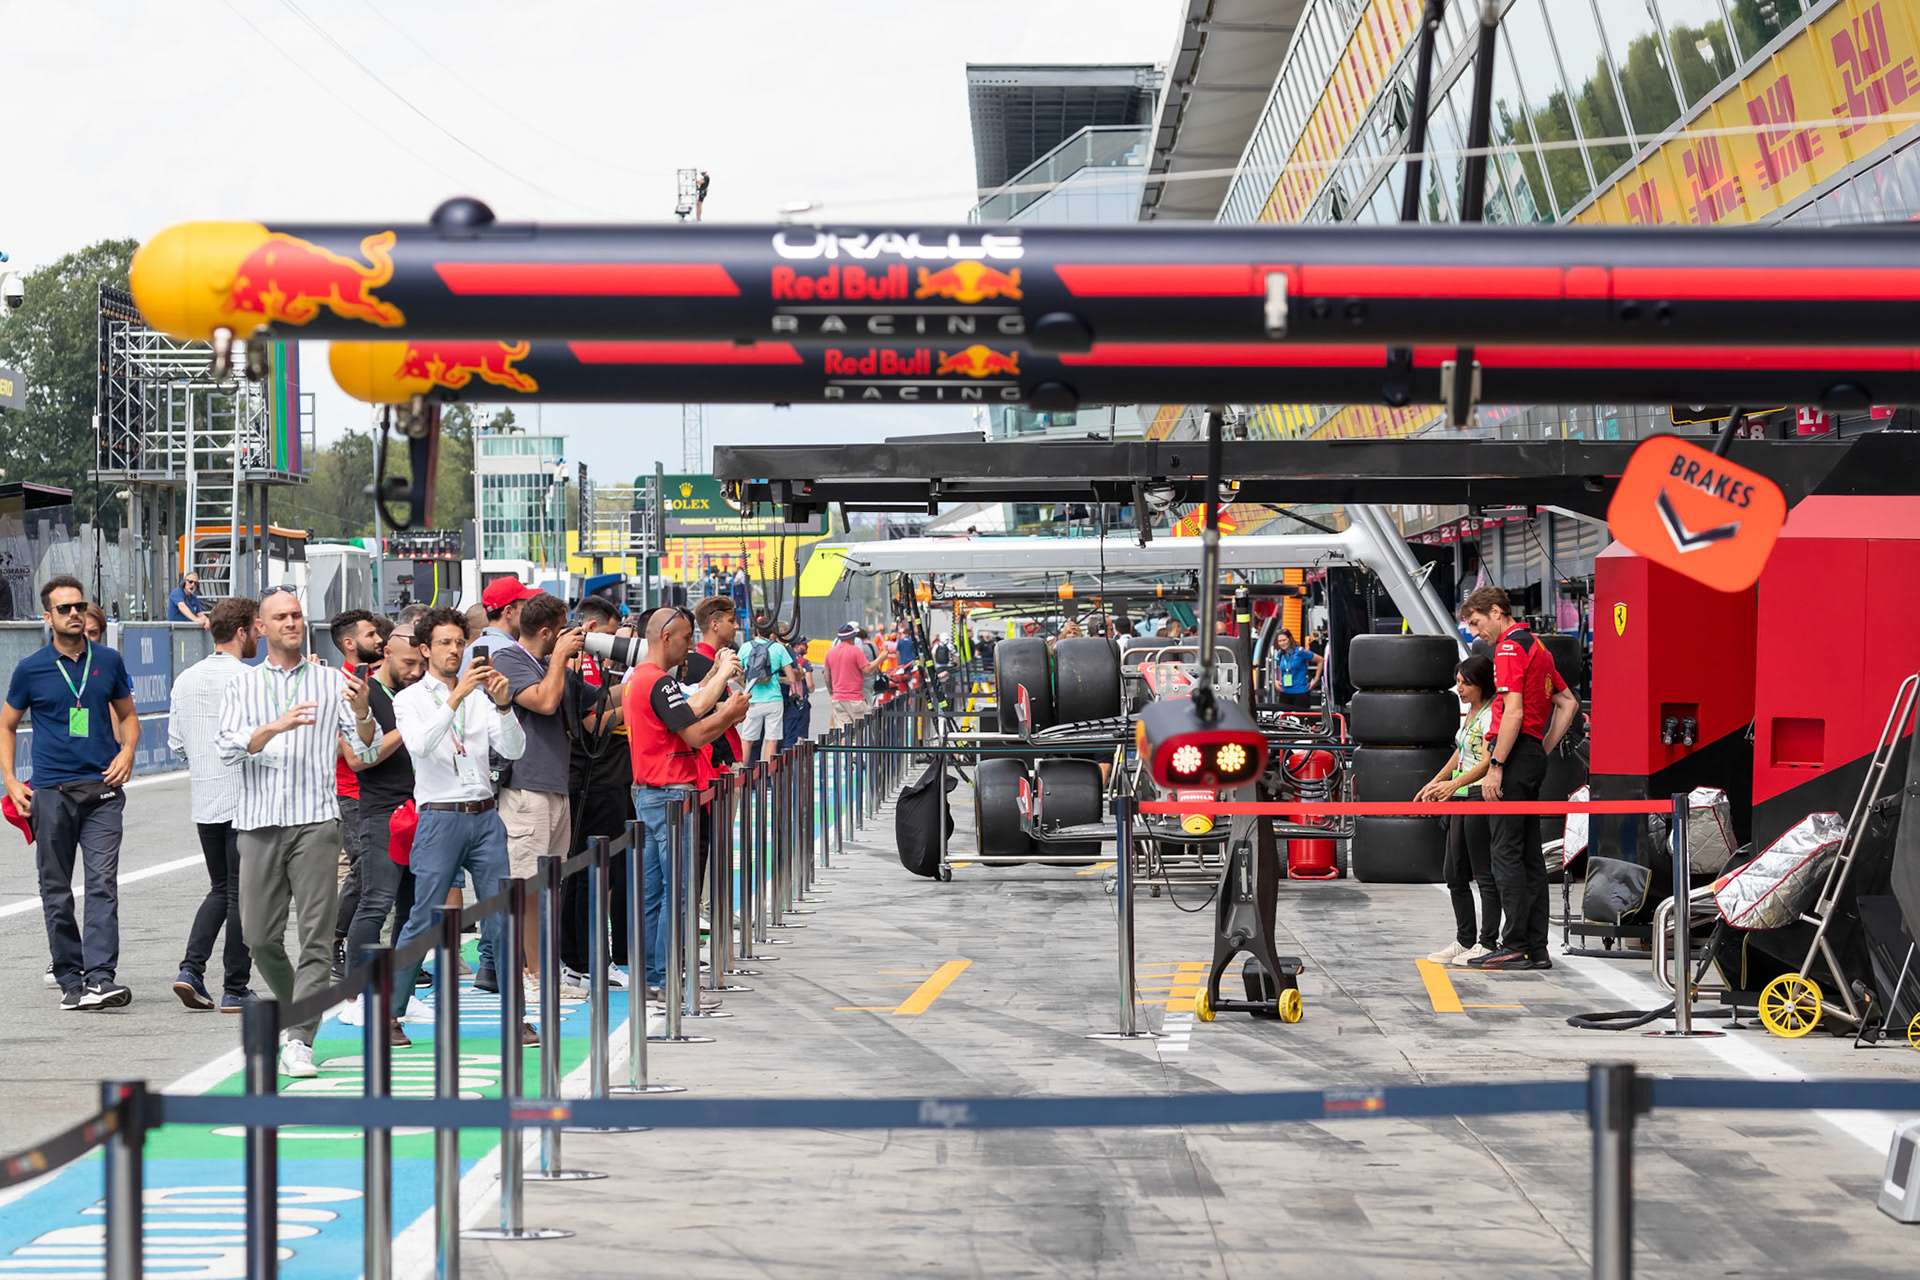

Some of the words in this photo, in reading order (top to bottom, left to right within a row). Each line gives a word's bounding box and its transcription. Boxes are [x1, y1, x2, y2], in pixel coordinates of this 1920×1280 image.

[771, 265, 839, 300] Red
[843, 264, 909, 300] Bull
[772, 315, 1025, 335] RACING
[824, 349, 877, 375] Red
[880, 349, 931, 375] Bull
[824, 385, 1021, 400] RACING
[1669, 453, 1755, 508] BRAKES
[663, 499, 710, 510] OLEX
[1461, 519, 1480, 530] 26
[1441, 526, 1458, 537] 27
[1423, 533, 1441, 544] 28
[956, 590, 987, 598] WORLD
